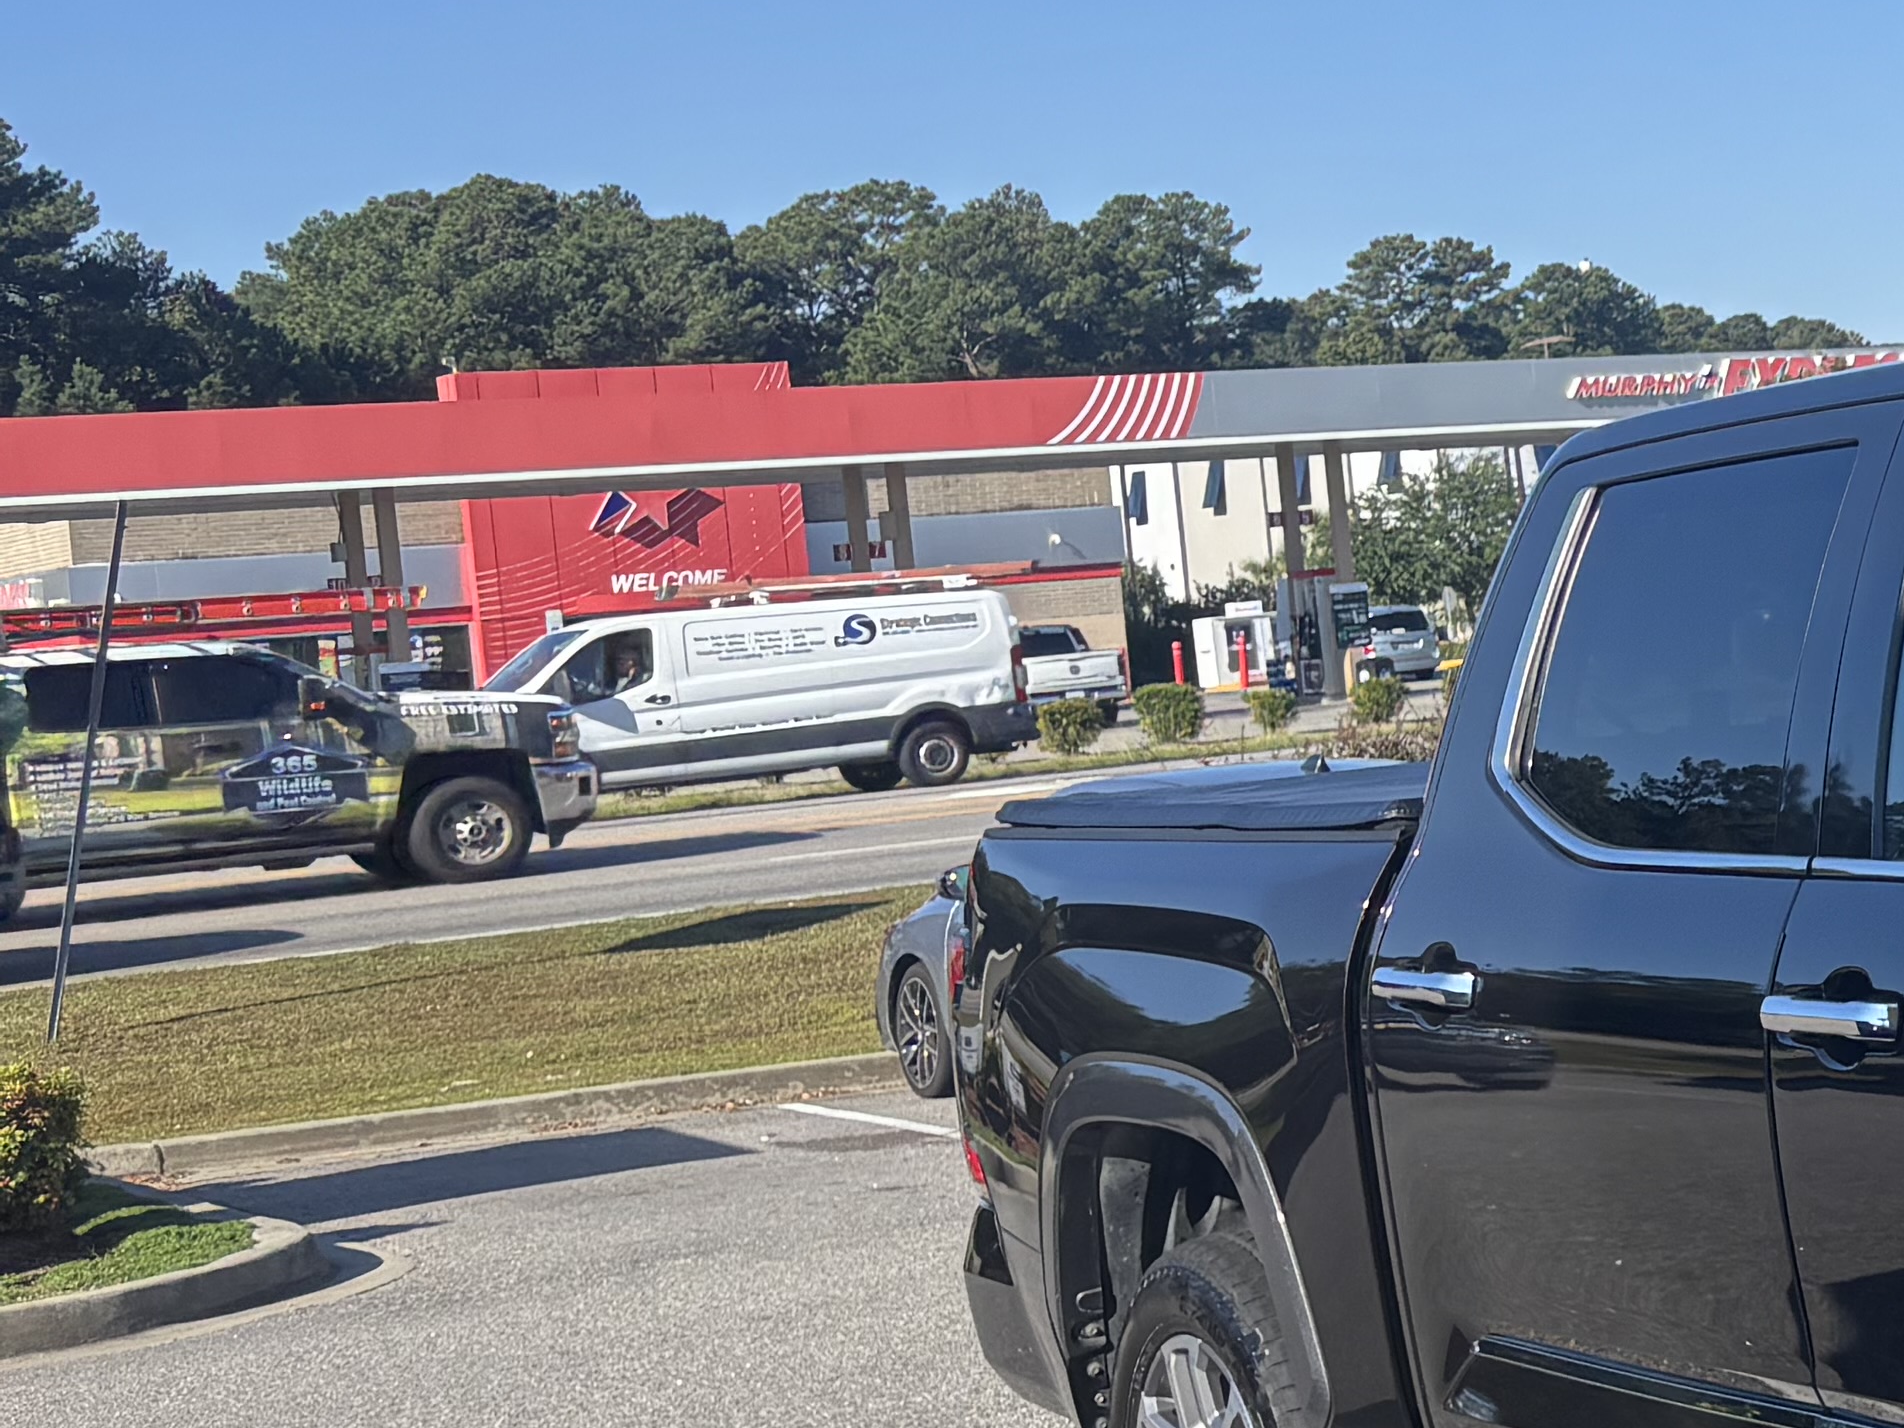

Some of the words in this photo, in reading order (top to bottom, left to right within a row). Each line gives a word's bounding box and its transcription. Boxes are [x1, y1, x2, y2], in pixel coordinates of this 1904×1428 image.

[1566, 372, 1699, 399] MURPHY
[611, 569, 728, 594] WELCOME
[270, 754, 318, 775] 365
[257, 776, 333, 797] Wildlife
